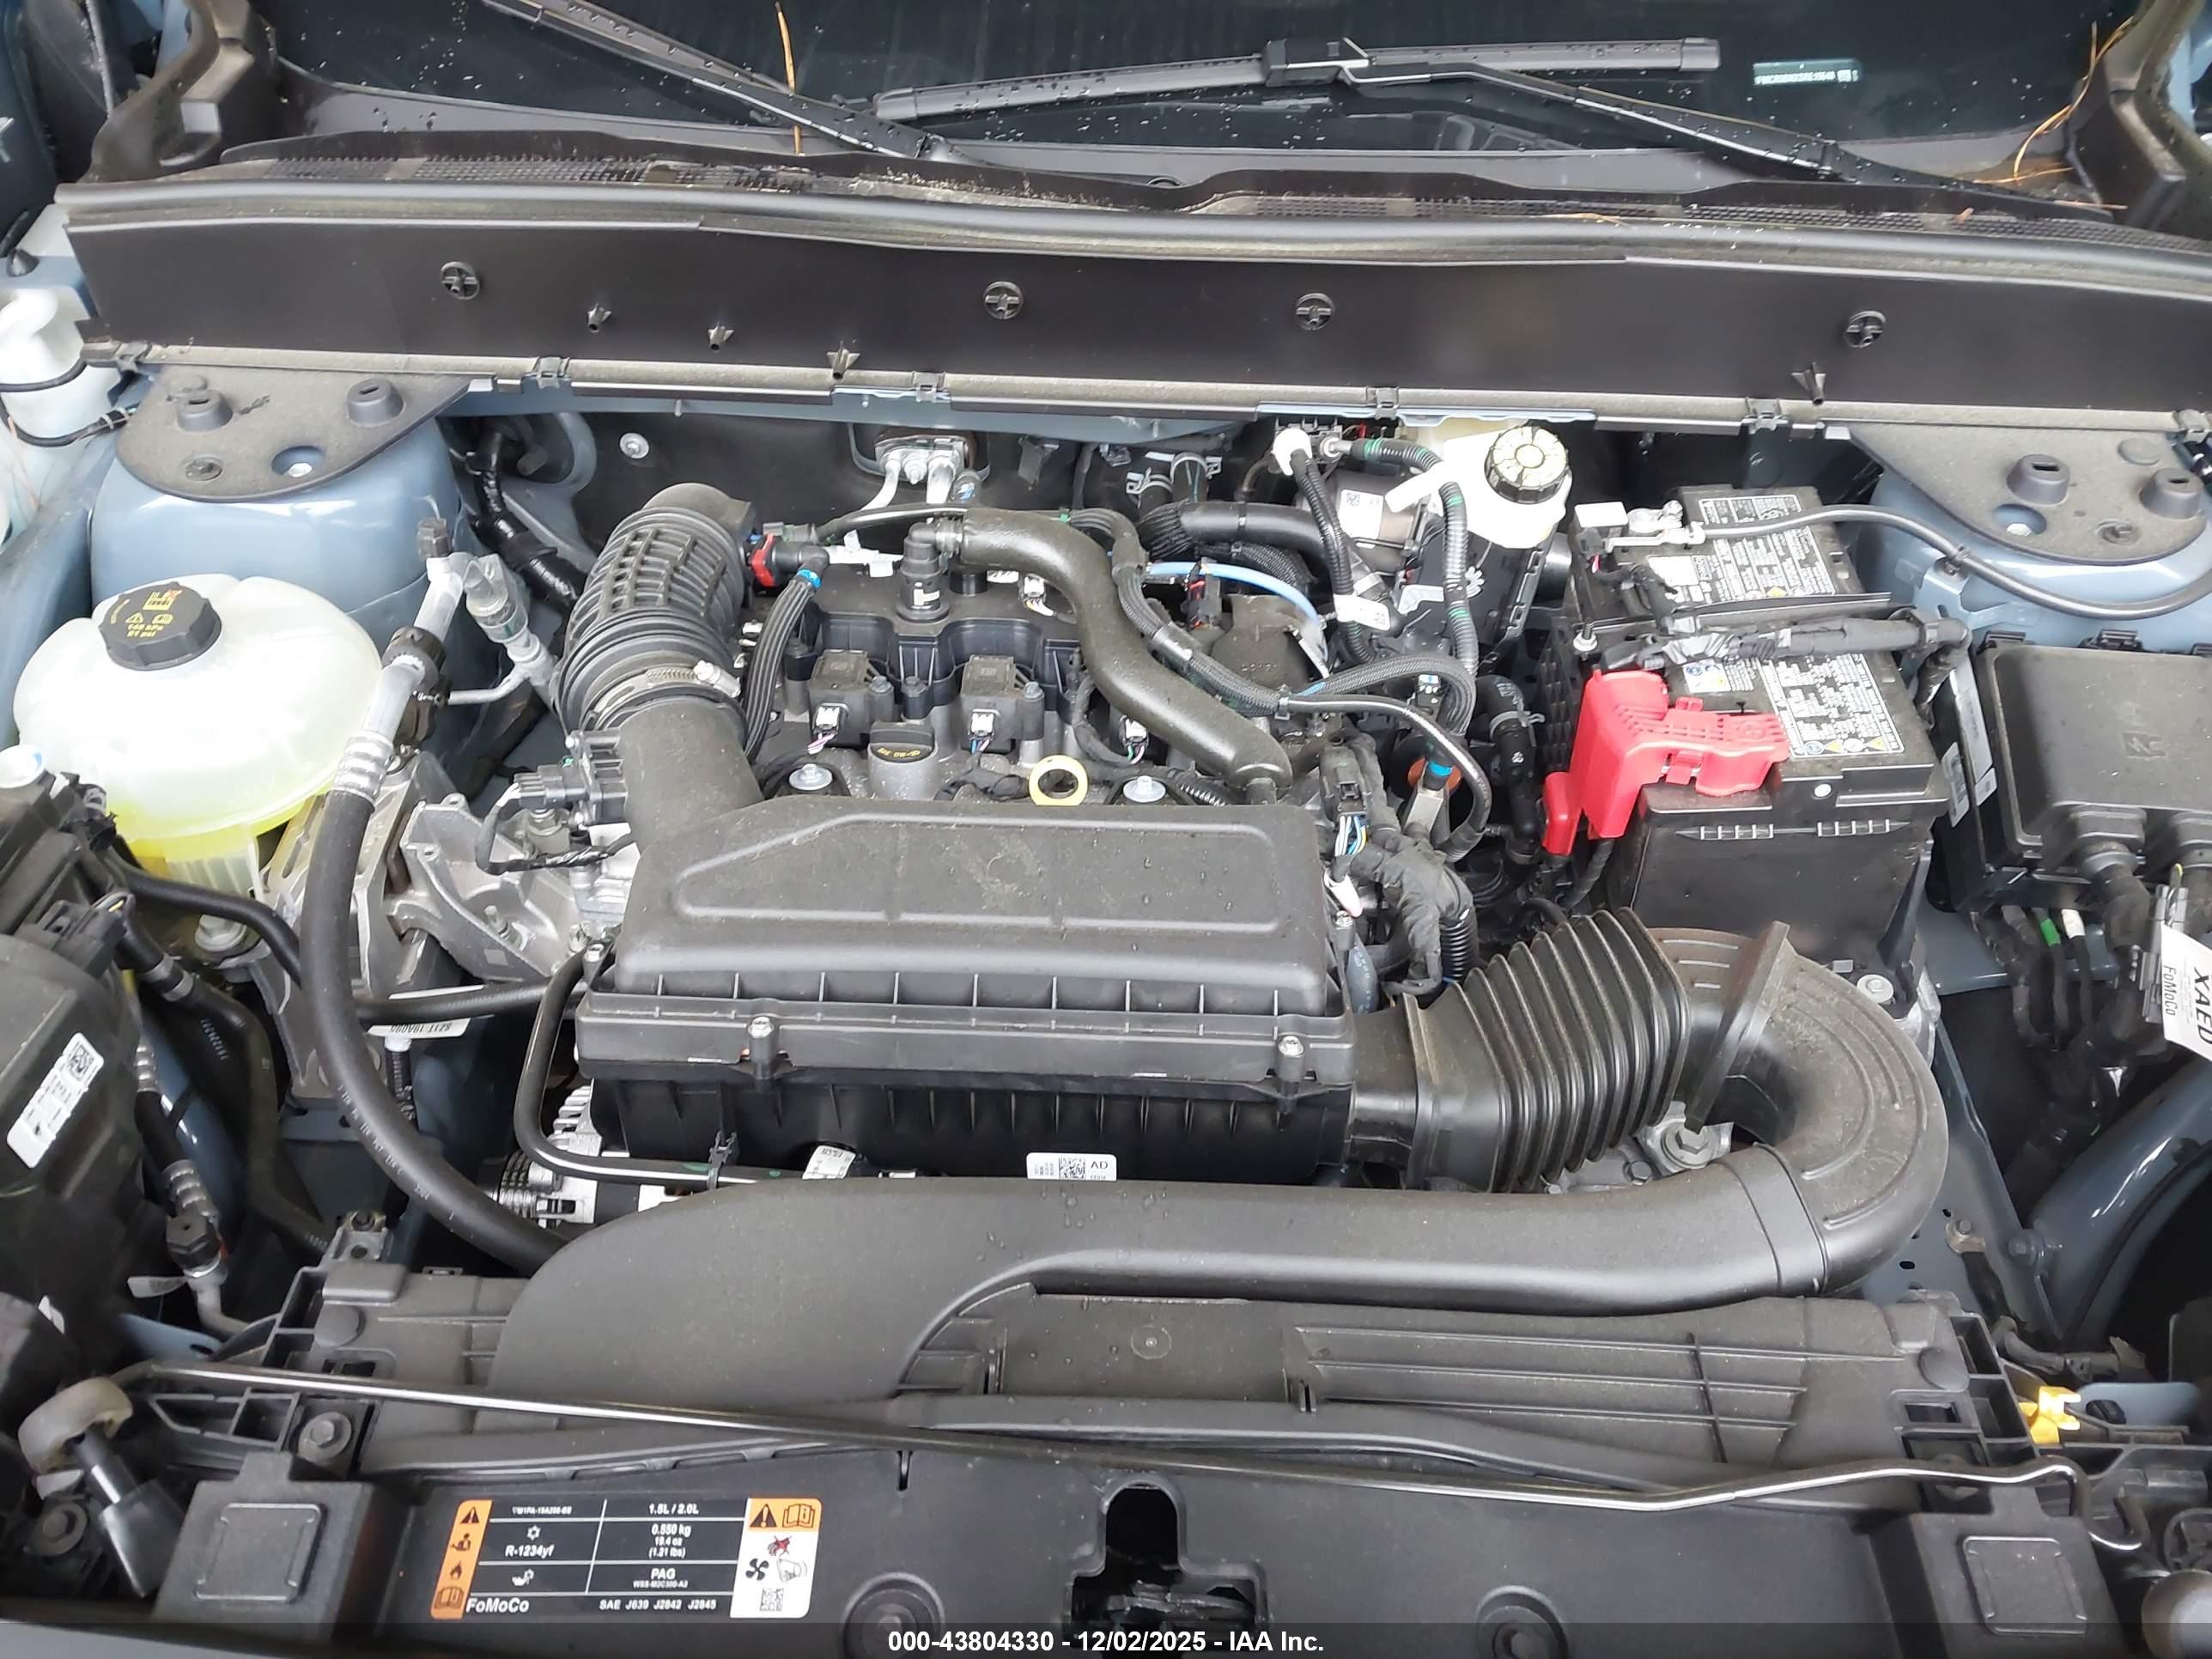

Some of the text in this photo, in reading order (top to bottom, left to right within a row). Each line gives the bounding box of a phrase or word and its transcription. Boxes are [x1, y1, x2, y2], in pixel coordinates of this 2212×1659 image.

[2162, 964, 2179, 1017] FoMoCo
[2193, 966, 2212, 1045] XAED
[1090, 1160, 1109, 1170] AD
[648, 1503, 700, 1515] 1.5L / 2.0L
[678, 1523, 692, 1538] kg
[672, 1537, 683, 1547] oz
[504, 1545, 556, 1559] R-1234yf
[670, 1547, 686, 1559] lbs)
[650, 1567, 676, 1580] PAG
[465, 1597, 530, 1613] FoMoCo
[599, 1599, 622, 1610] SAE
[624, 1599, 649, 1610] J639
